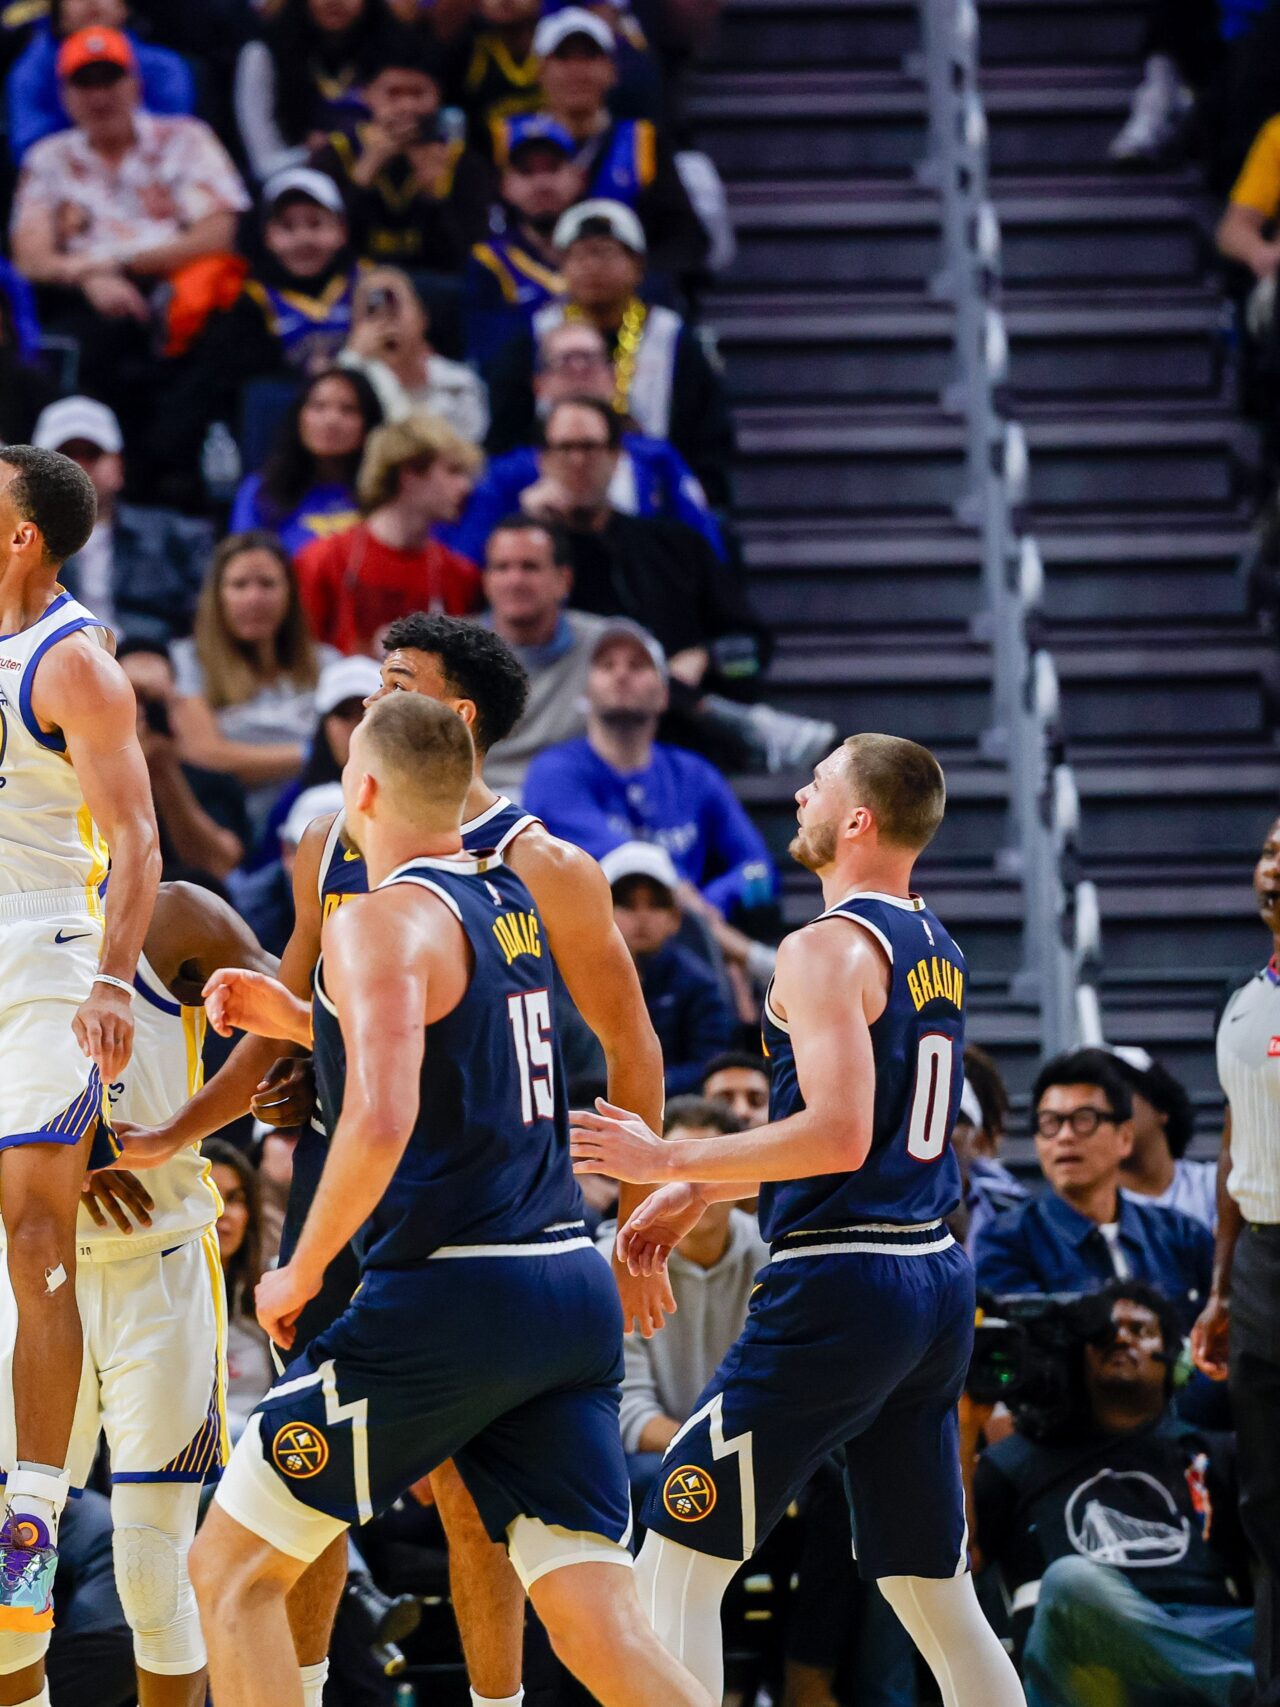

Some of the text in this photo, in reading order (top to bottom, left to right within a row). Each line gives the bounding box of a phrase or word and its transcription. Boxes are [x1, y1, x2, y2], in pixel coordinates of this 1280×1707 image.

[491, 908, 542, 966] JOKIĆ
[906, 955, 963, 1012] BRAUN
[506, 987, 555, 1127] 15
[906, 1031, 954, 1164] 0
